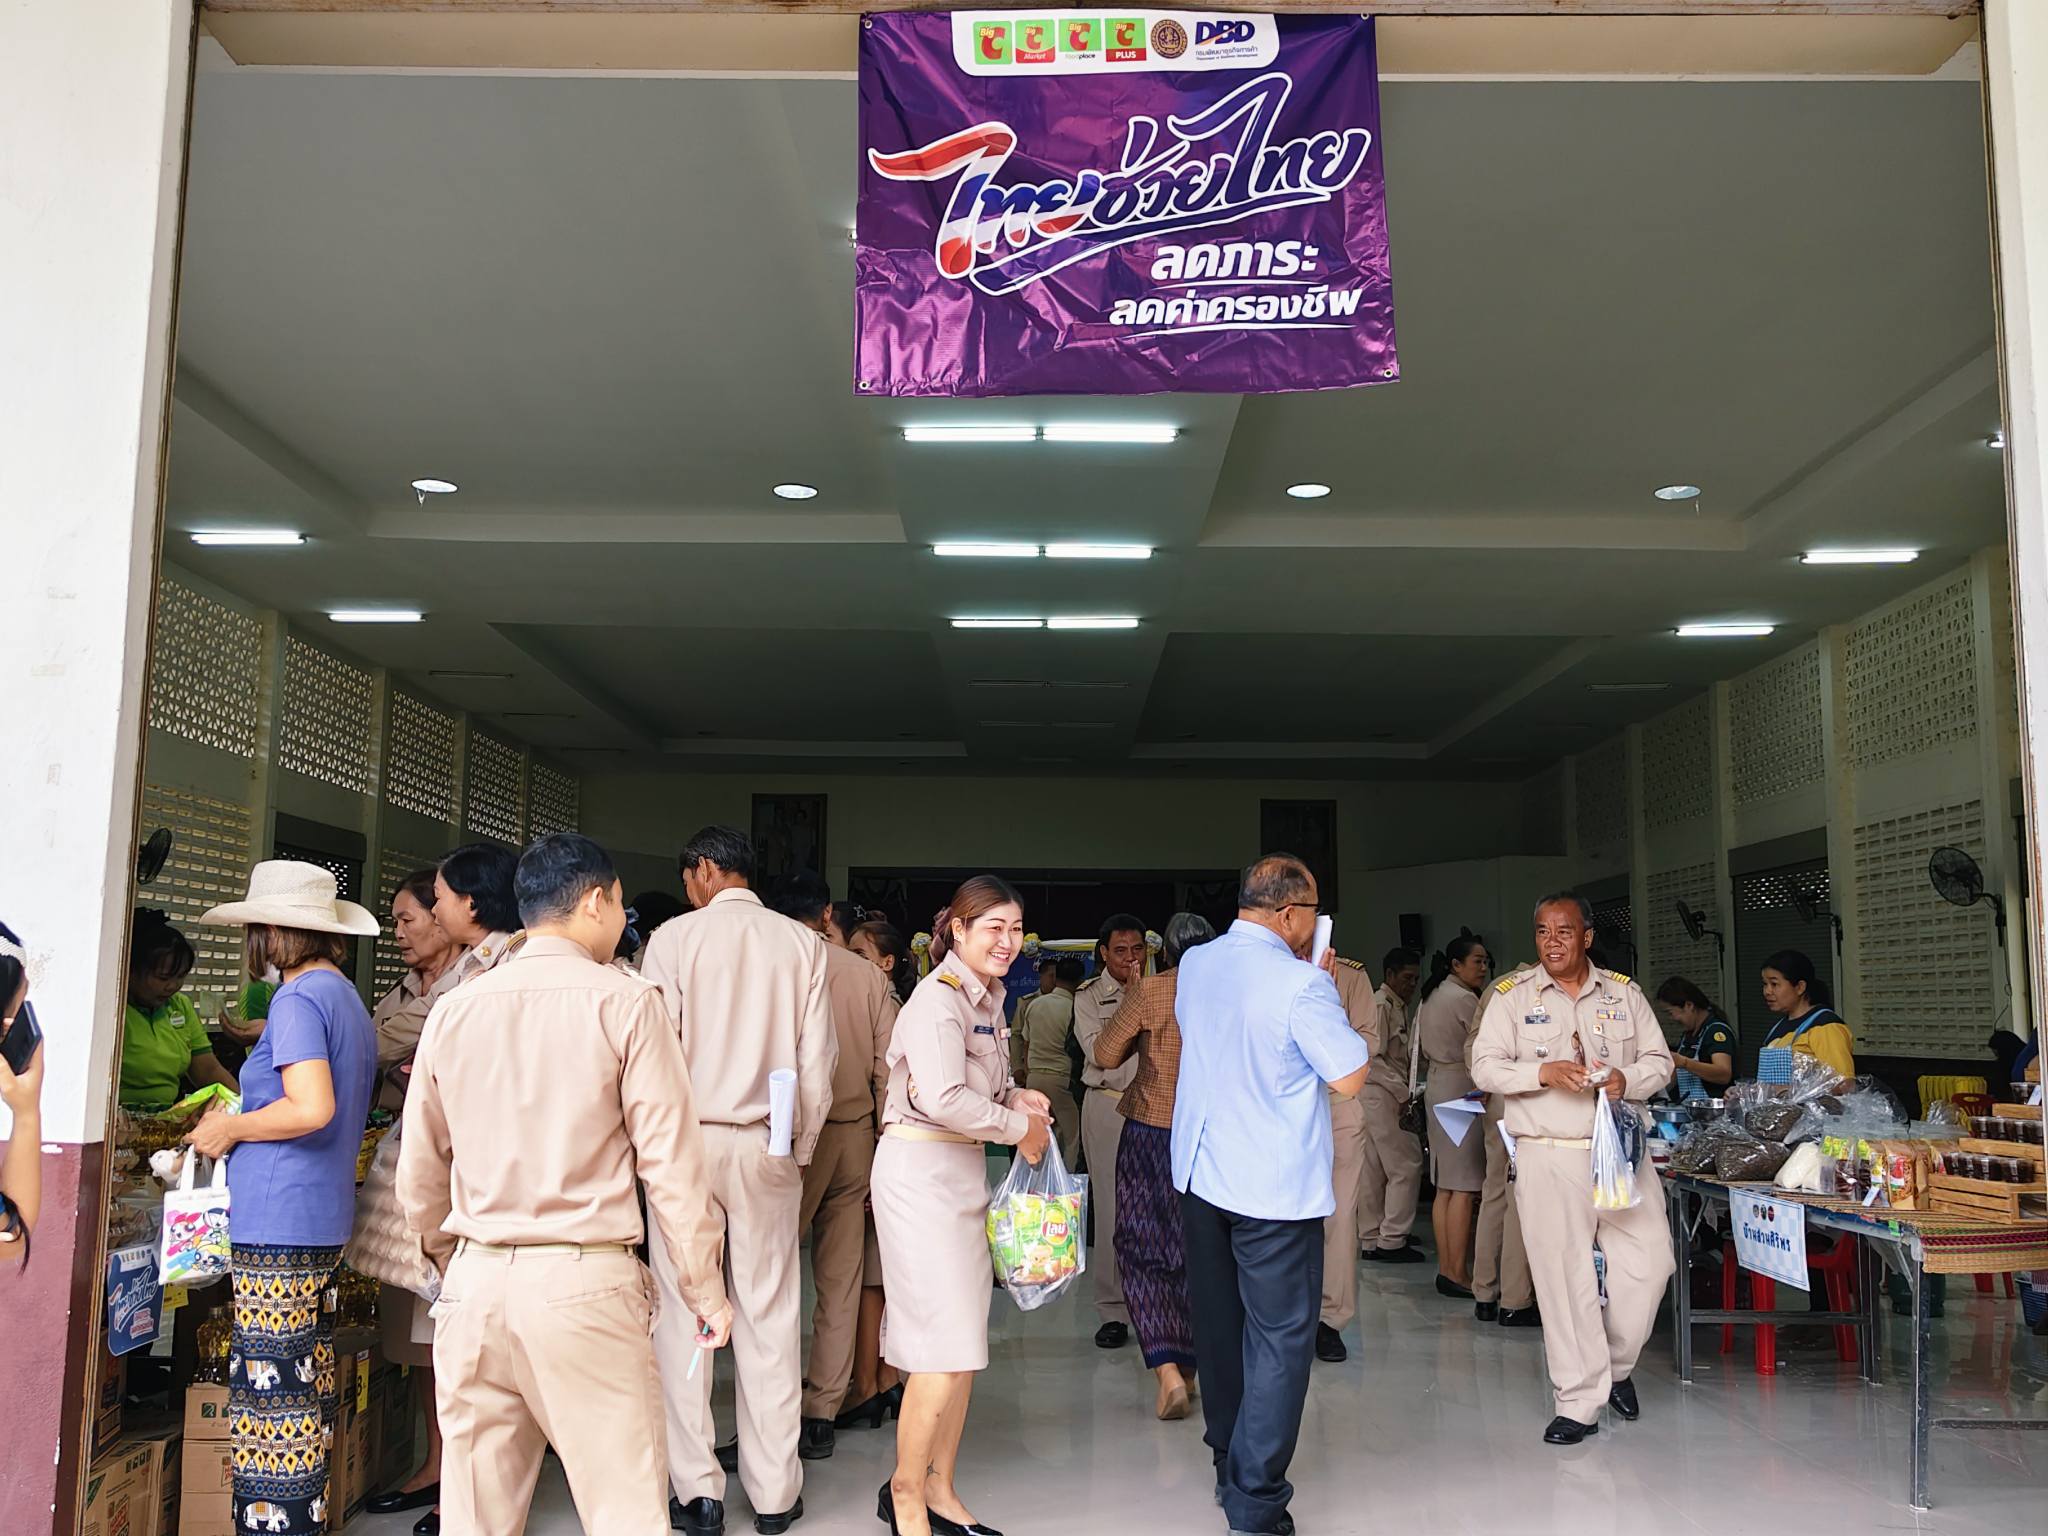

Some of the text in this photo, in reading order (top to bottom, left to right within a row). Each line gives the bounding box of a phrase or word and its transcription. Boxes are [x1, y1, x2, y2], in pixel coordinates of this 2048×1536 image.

[1069, 22, 1082, 32] Big
[1115, 23, 1127, 31] Big
[980, 28, 995, 38] Big
[1195, 20, 1256, 45] DBD
[1115, 50, 1137, 59] PLUS
[1150, 240, 1320, 281] ลดภาระ
[1108, 284, 1364, 326] ลดค่าครองชีพ
